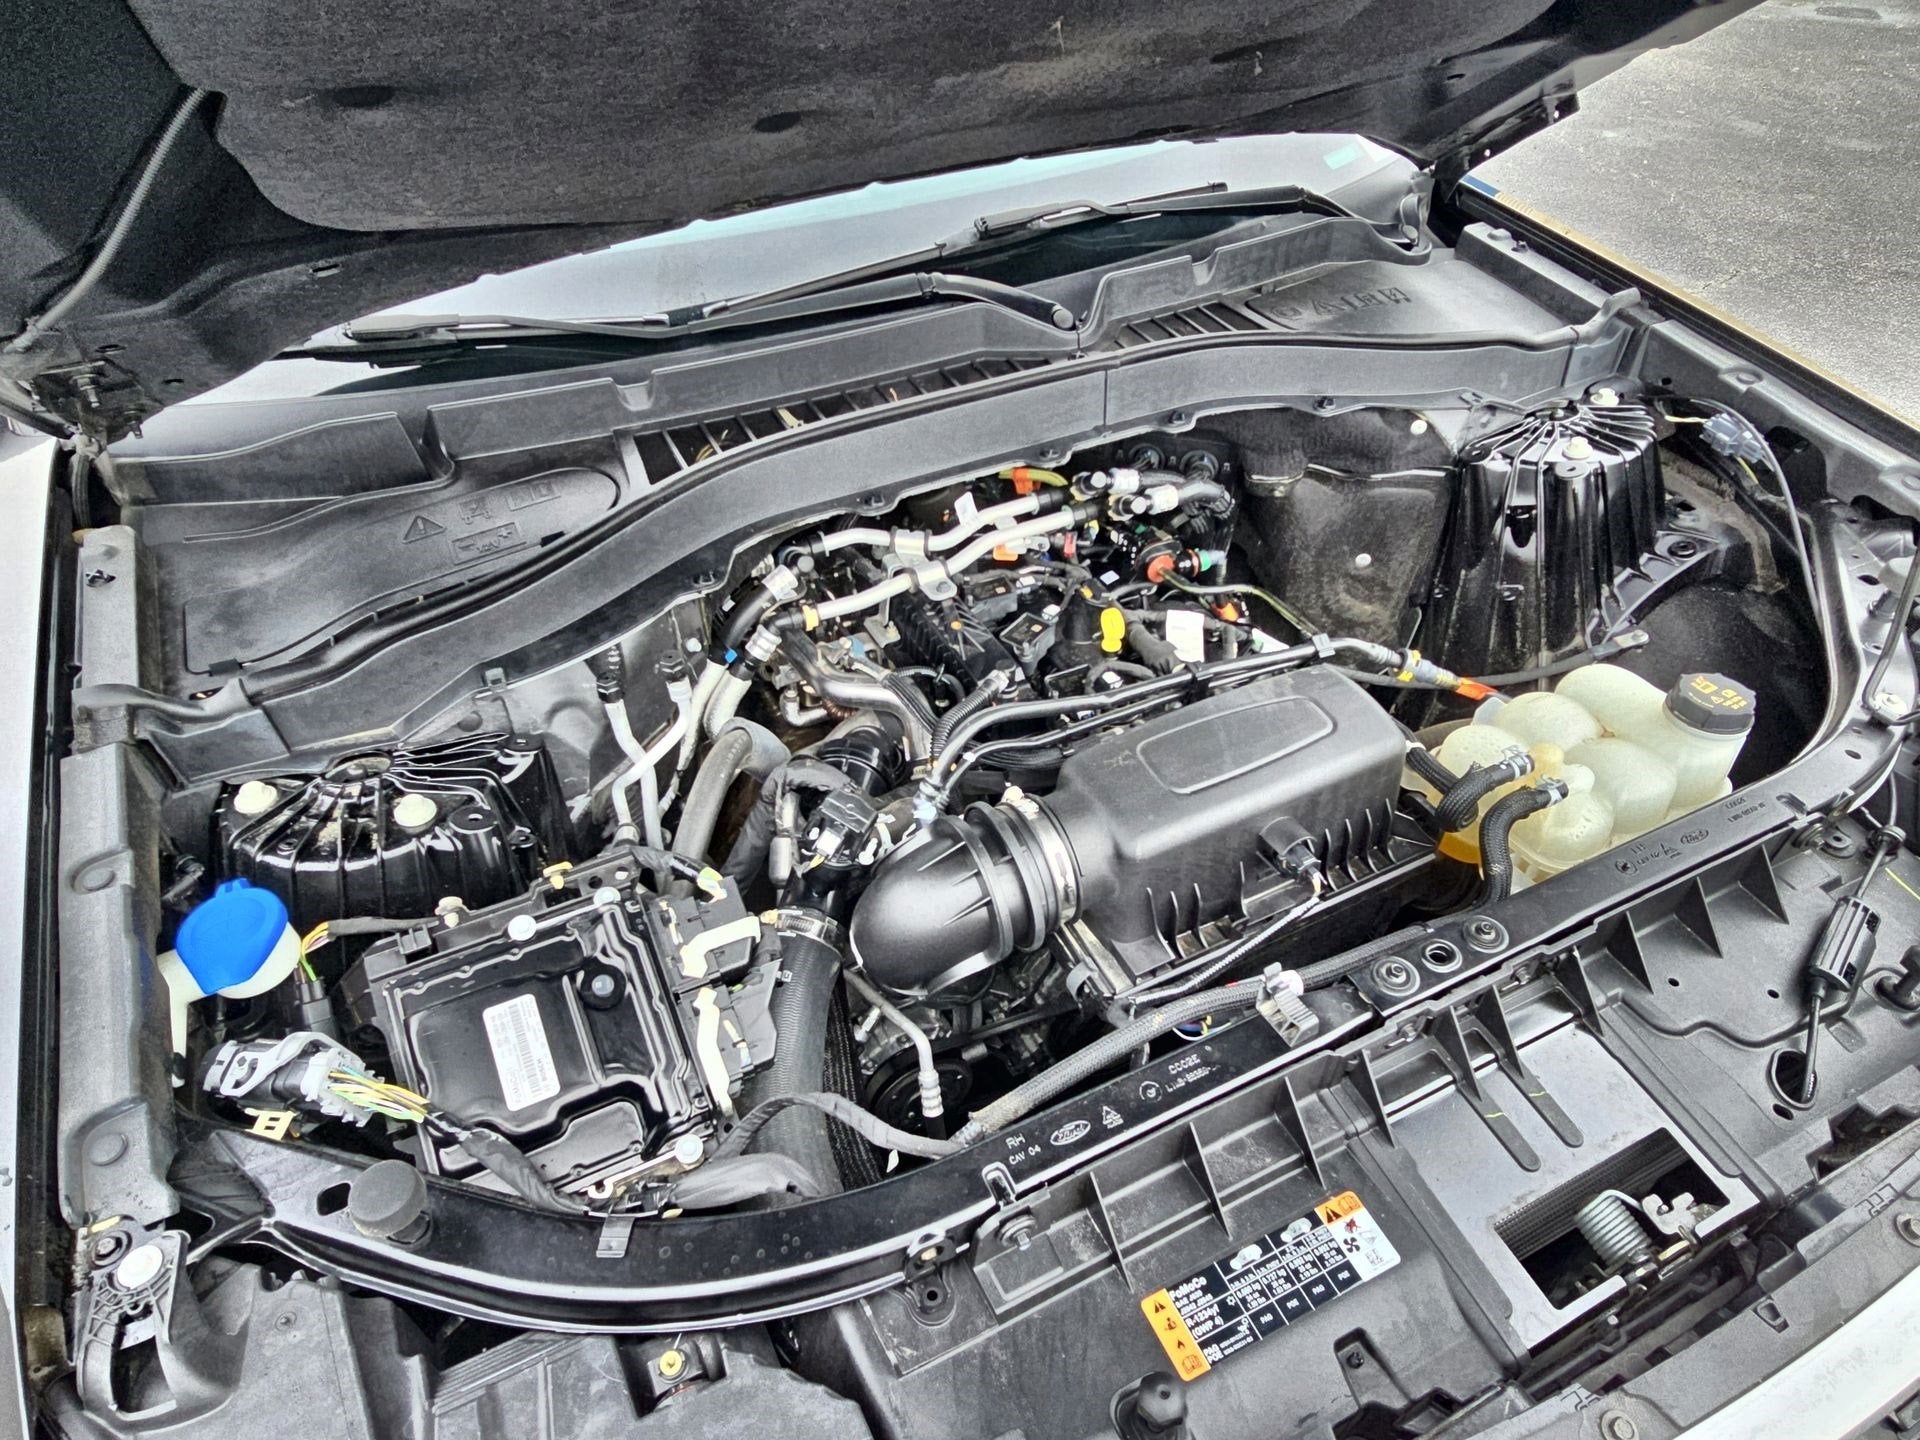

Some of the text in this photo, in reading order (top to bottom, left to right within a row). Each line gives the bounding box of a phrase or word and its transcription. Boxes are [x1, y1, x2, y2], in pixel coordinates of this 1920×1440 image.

[1055, 1123, 1087, 1143] Ford
[1005, 1132, 1026, 1150] RH
[1008, 1144, 1042, 1166] CAV 04
[1327, 1240, 1338, 1248] kg
[1303, 1253, 1313, 1262] kg
[1276, 1268, 1287, 1276] kg
[1337, 1270, 1350, 1280] POE
[1168, 1277, 1206, 1300] FoMoCo
[1251, 1282, 1261, 1290] kg
[1312, 1284, 1325, 1294] PAG
[1286, 1298, 1299, 1309] POE
[1185, 1304, 1219, 1327] R-1234yf
[1260, 1313, 1273, 1324] PAG
[1192, 1320, 1213, 1338] (GWP
[1214, 1315, 1224, 1325] 4)
[1203, 1344, 1219, 1357] PAG
[1207, 1350, 1223, 1363] POE
